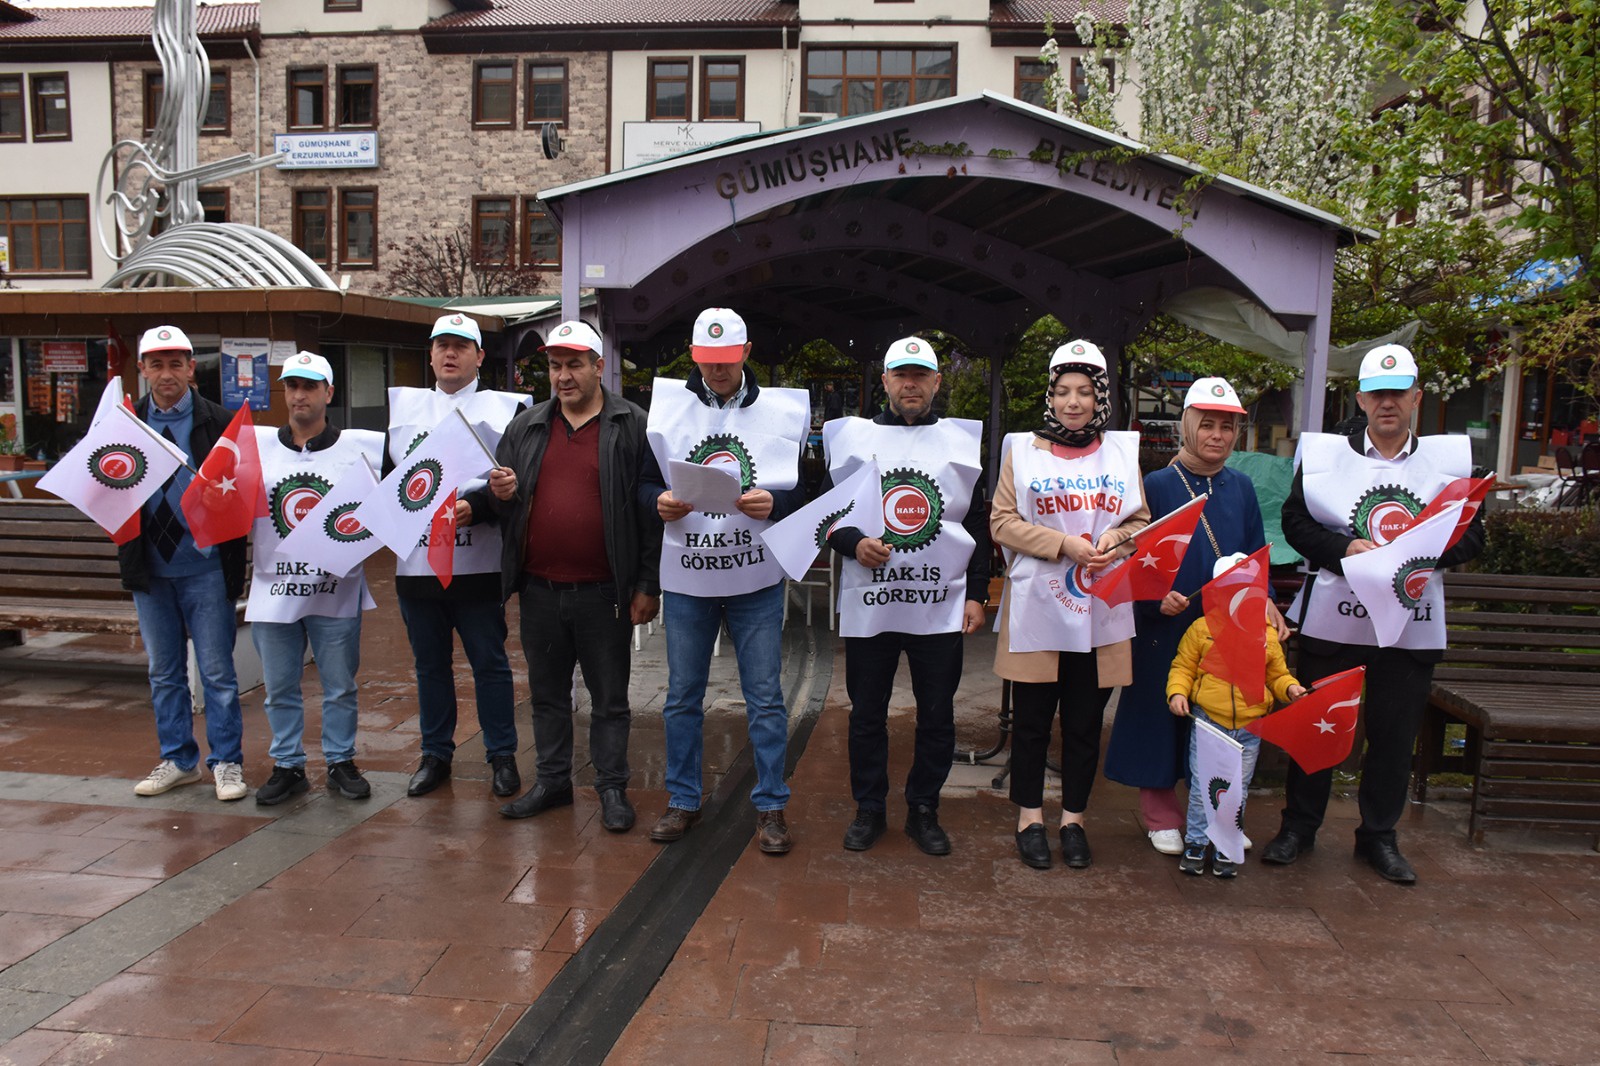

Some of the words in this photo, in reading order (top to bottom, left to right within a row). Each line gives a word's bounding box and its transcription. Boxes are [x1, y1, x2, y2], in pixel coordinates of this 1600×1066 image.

[298, 139, 352, 148] GÜMÜŞHANE
[292, 151, 358, 159] ERZURUMLULAR
[715, 127, 911, 200] GÜMÜŞHANE
[1030, 477, 1053, 493] ÖZ
[1057, 474, 1125, 498] SAĞLIK-İŞ
[896, 506, 926, 514] HAK-İŞ
[1036, 492, 1123, 516] SENDİKASI
[685, 528, 752, 547] HAK-İŞ
[681, 544, 765, 570] GÖREVLİ
[871, 564, 941, 585] HAK-İŞ
[270, 580, 338, 597] GÖREVLİ
[863, 585, 949, 606] GÖREVLİ
